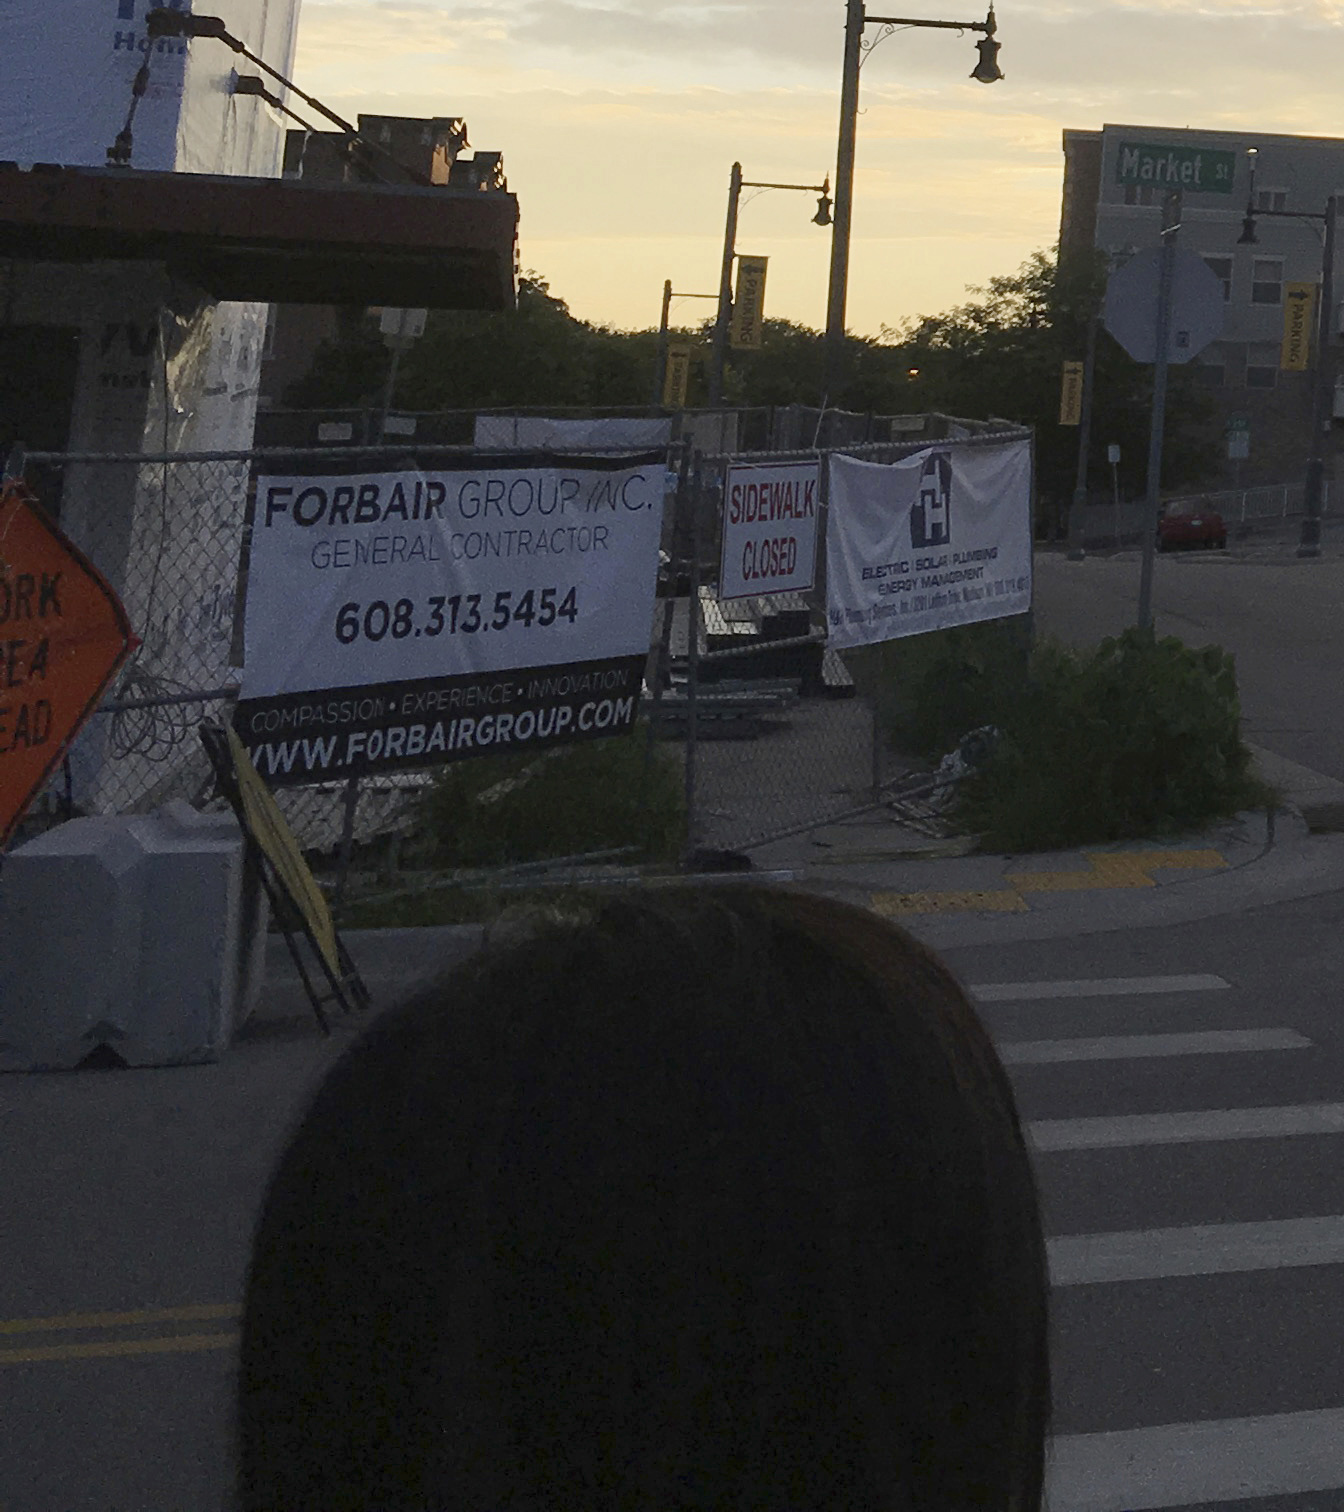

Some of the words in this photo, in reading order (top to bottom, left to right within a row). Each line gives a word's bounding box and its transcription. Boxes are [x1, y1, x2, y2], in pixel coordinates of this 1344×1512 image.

[1121, 147, 1202, 184] Market
[1289, 304, 1304, 363] PARKING
[264, 481, 446, 527] FORBAIR
[458, 478, 581, 519] GROUP
[730, 480, 816, 524] SIDEWALK
[311, 535, 440, 569] GENERAL
[451, 526, 610, 560] CONTRACTOR
[742, 537, 796, 581] CLOSED
[861, 561, 910, 580] ELECTRIC
[953, 547, 998, 565] PLUMBING
[878, 578, 918, 596] ENERGY
[921, 566, 984, 589] MANAGEMENT
[335, 586, 579, 644] 608.313.5454
[251, 698, 385, 733] COMPASSION
[401, 681, 512, 716] EXPERIENCE
[528, 669, 630, 698] INNOVATION
